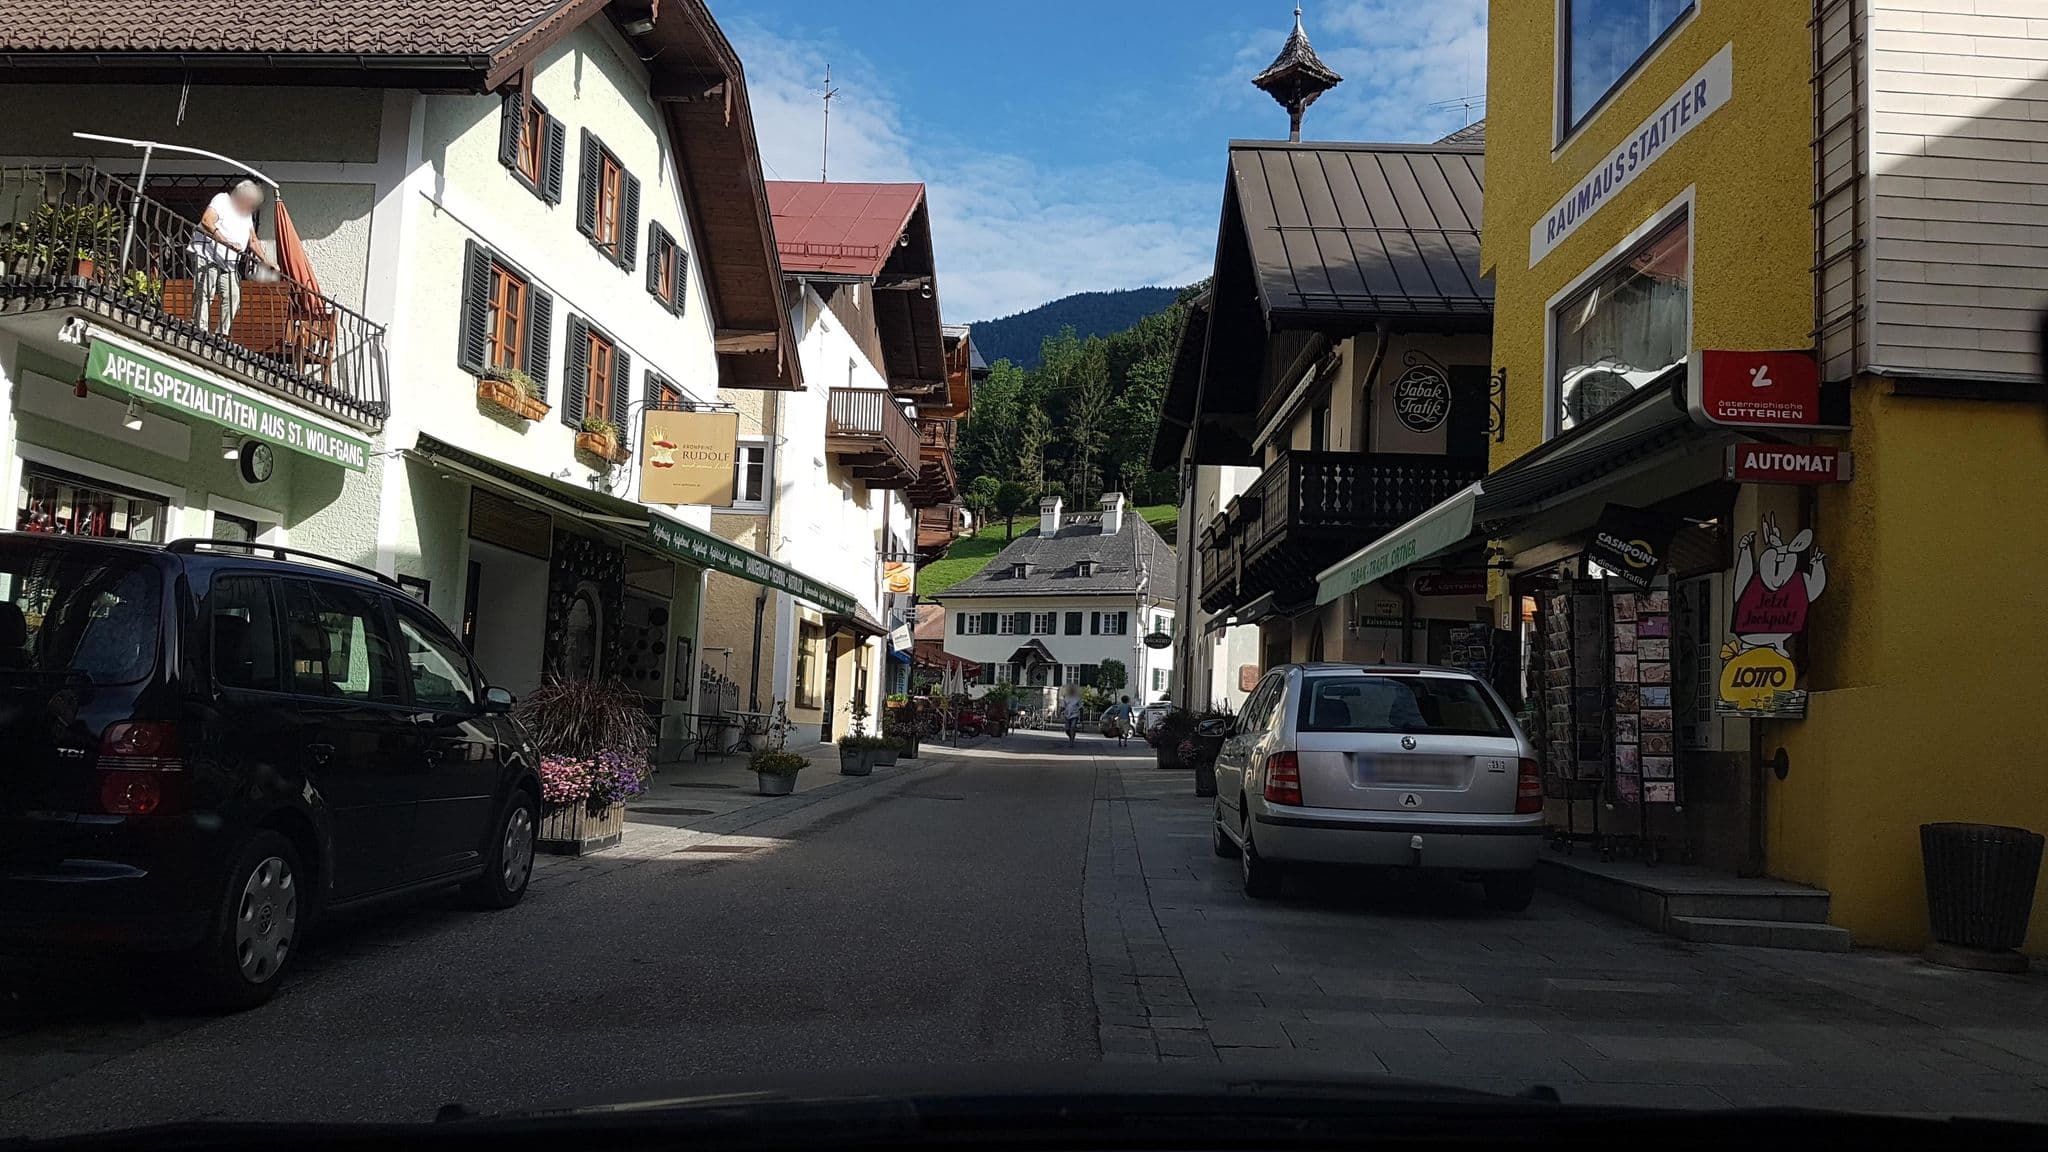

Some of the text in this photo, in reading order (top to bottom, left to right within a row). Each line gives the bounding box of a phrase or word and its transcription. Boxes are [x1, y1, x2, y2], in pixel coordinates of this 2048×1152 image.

[1547, 79, 1707, 244] RAUMAUSSTATTER
[1400, 380, 1446, 400] Tabak
[102, 352, 364, 467] APFELSPEZIALITÄTEN AUS ST. WOLFGANG
[1399, 397, 1445, 417] Trafik
[1718, 400, 1803, 410] österreichische
[1718, 408, 1803, 419] LOTTERIEN
[682, 451, 730, 461] RUDOLF
[1744, 452, 1834, 472] AUTOMAT
[1598, 532, 1659, 566] CASHPOINT
[1598, 558, 1621, 575] dieser
[1755, 592, 1789, 609] Jetzt
[1743, 611, 1798, 630] Jackpot!
[1731, 666, 1787, 688] LOTTO
[1404, 794, 1417, 805] A
